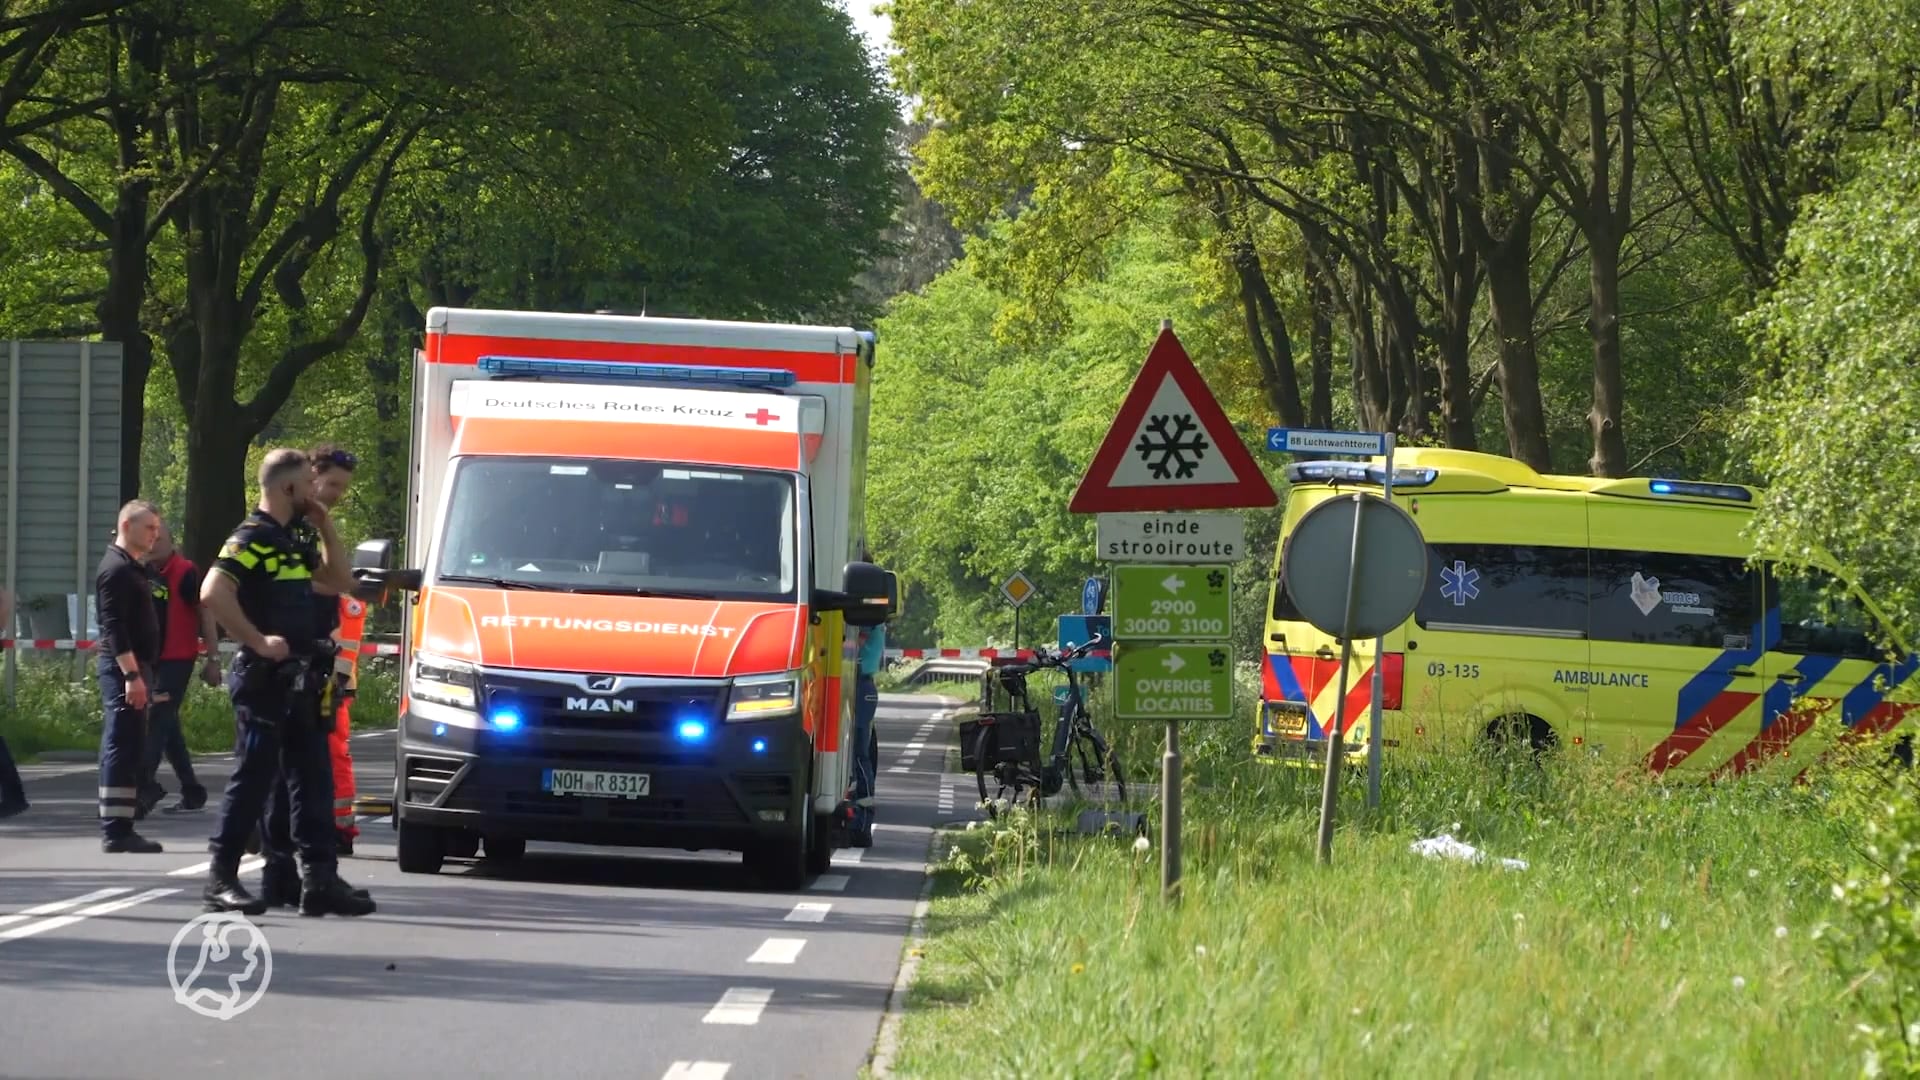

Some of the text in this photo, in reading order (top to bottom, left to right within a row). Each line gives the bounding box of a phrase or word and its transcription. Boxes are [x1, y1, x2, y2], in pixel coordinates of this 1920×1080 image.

[485, 398, 735, 418] Deutsches Rotes Kreuz
[1304, 437, 1378, 449] Luchtwachttoren
[1143, 519, 1200, 534] einde
[1109, 540, 1234, 555] strooiroute
[1151, 600, 1196, 615] 2900
[481, 615, 735, 638] RETTUNGSDIENST
[1125, 619, 1223, 633] 3000 3100
[1427, 662, 1480, 679] 03-135
[1553, 669, 1649, 688] AMBULANCE
[1136, 679, 1212, 694] OVERIGE
[566, 696, 634, 713] MAN
[1135, 698, 1214, 712] LOCATIES
[553, 771, 649, 793] NOH R 8317
